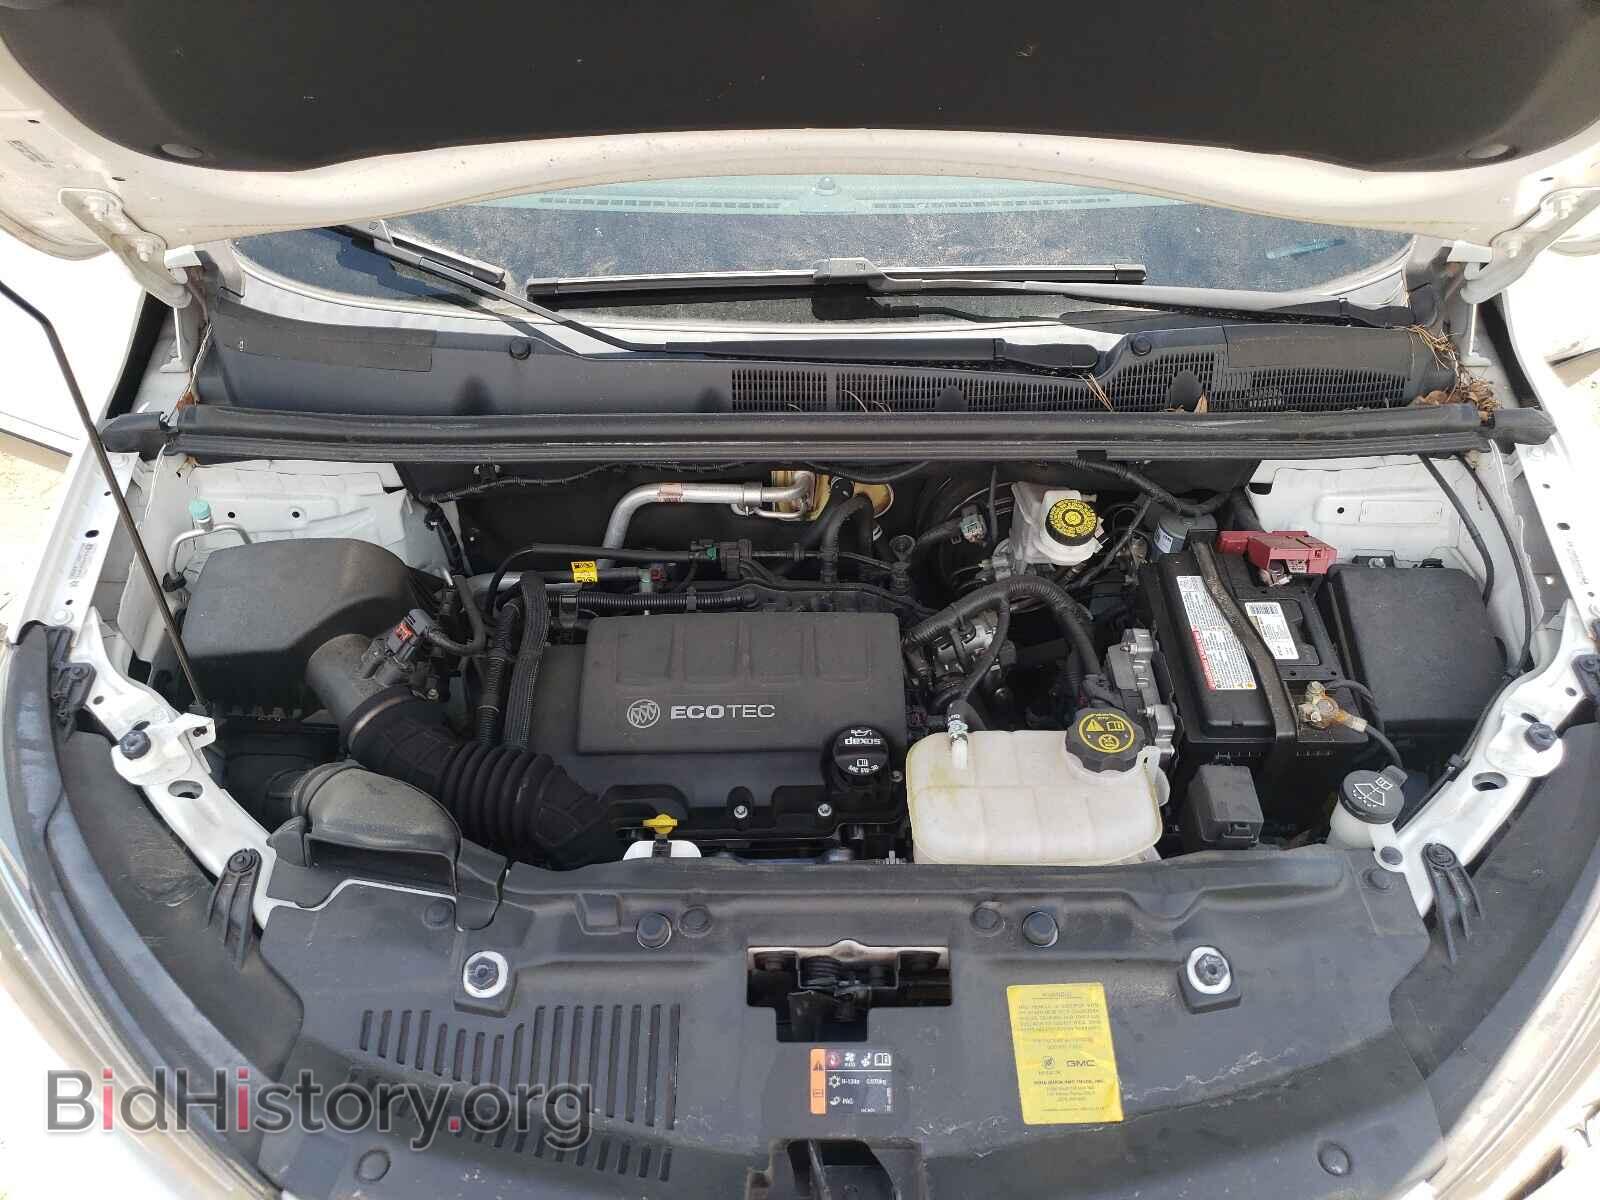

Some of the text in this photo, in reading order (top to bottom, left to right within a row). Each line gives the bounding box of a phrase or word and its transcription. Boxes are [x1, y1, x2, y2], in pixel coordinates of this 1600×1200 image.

[670, 704, 776, 720] ECOTEC
[844, 736, 881, 745] dexos
[1066, 1059, 1097, 1068] GMC
